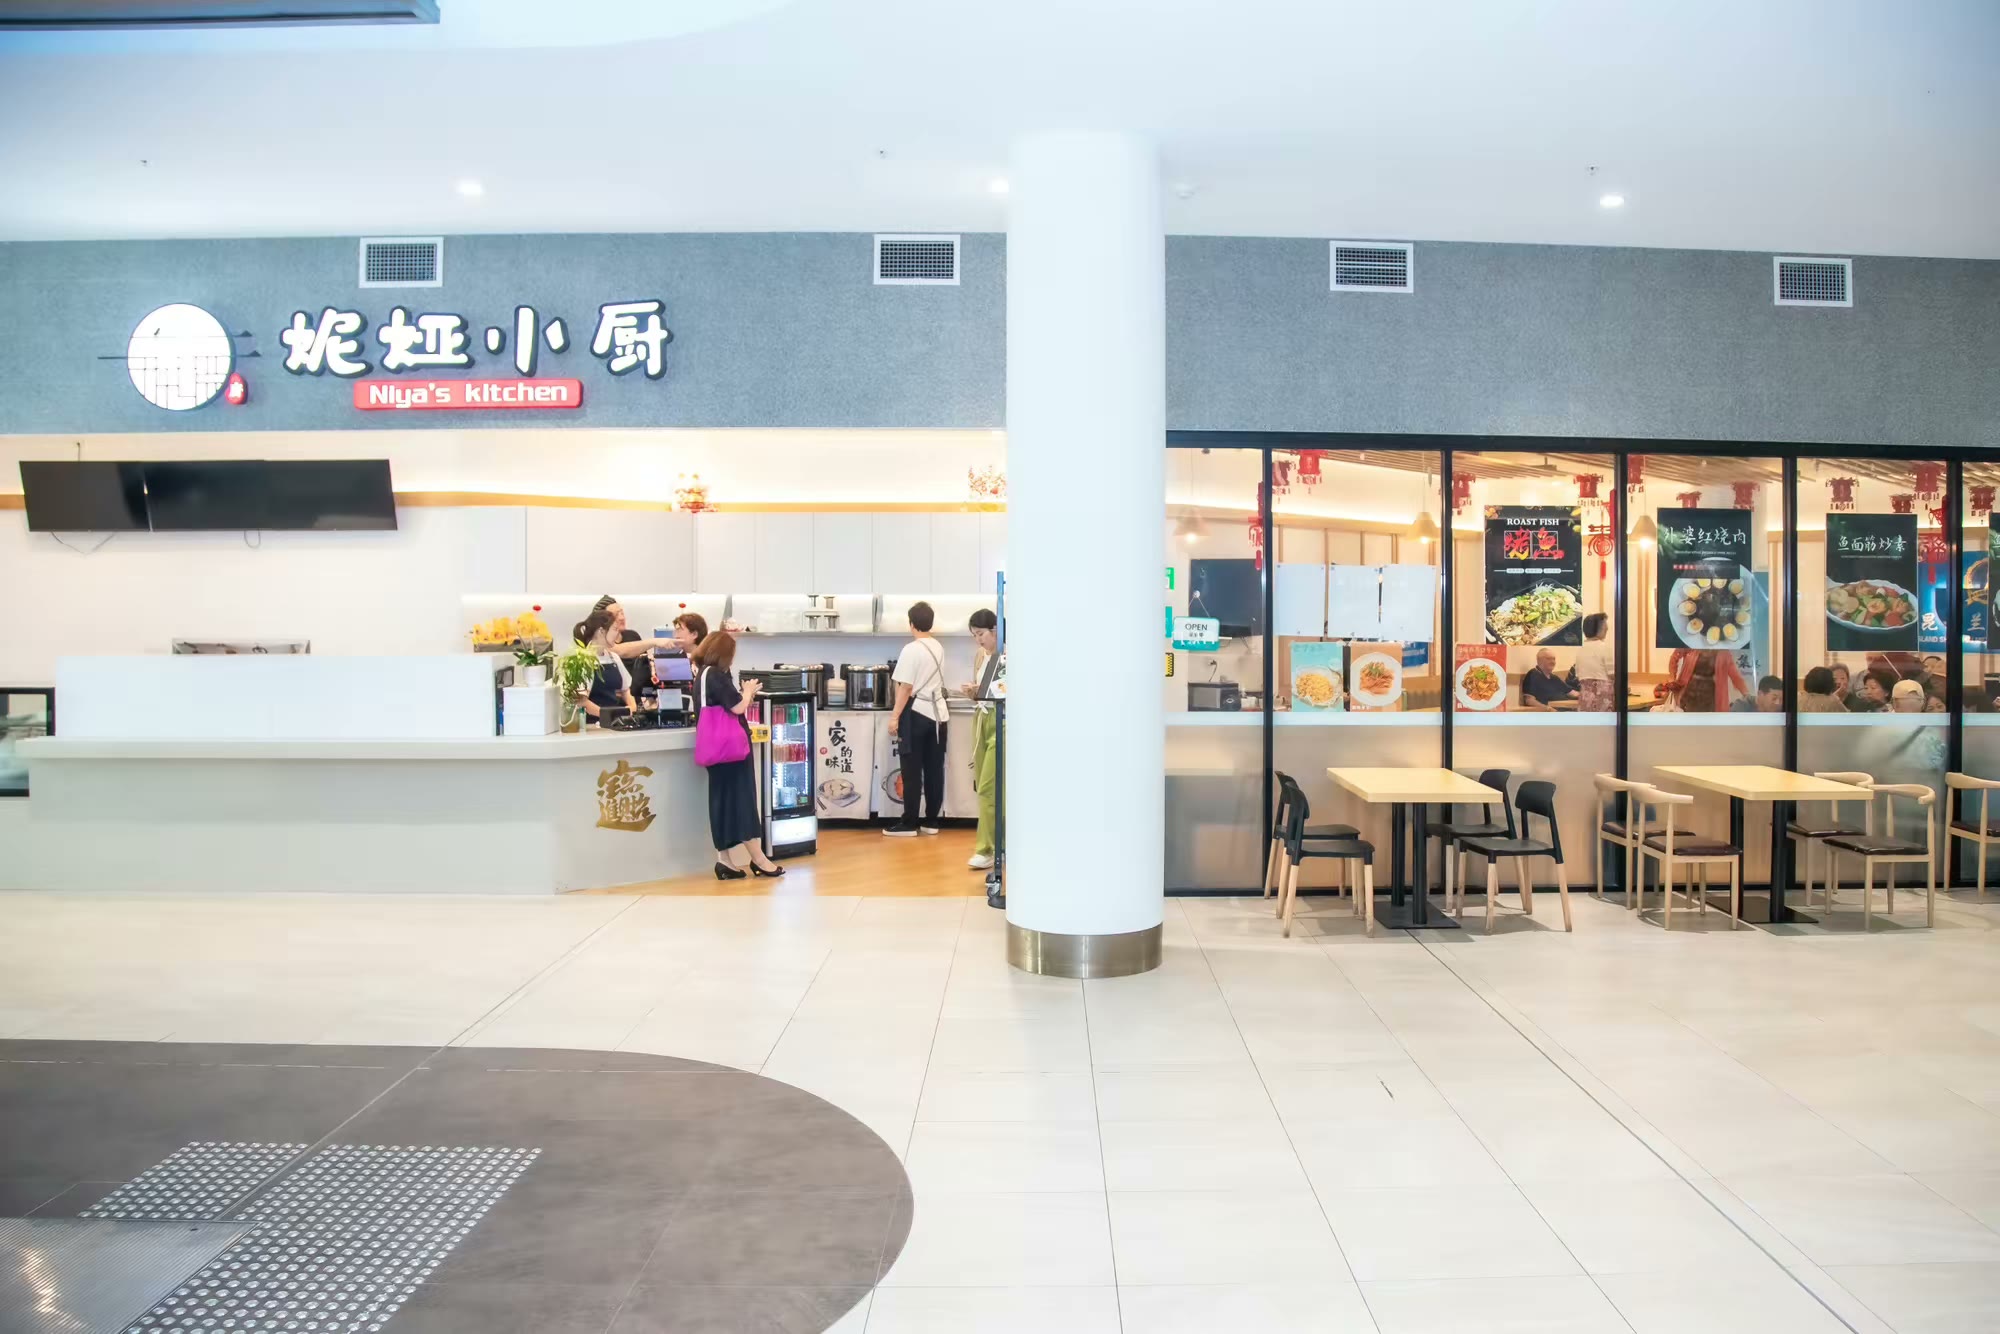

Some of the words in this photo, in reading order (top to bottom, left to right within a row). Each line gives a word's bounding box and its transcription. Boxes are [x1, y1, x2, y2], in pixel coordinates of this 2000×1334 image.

[281, 301, 671, 376] 妮娅小厨
[1506, 518, 1537, 526] ROAST
[1540, 518, 1559, 526] FISH
[1663, 525, 1747, 546] 外婆红烧肉
[1184, 623, 1208, 631] OPEN
